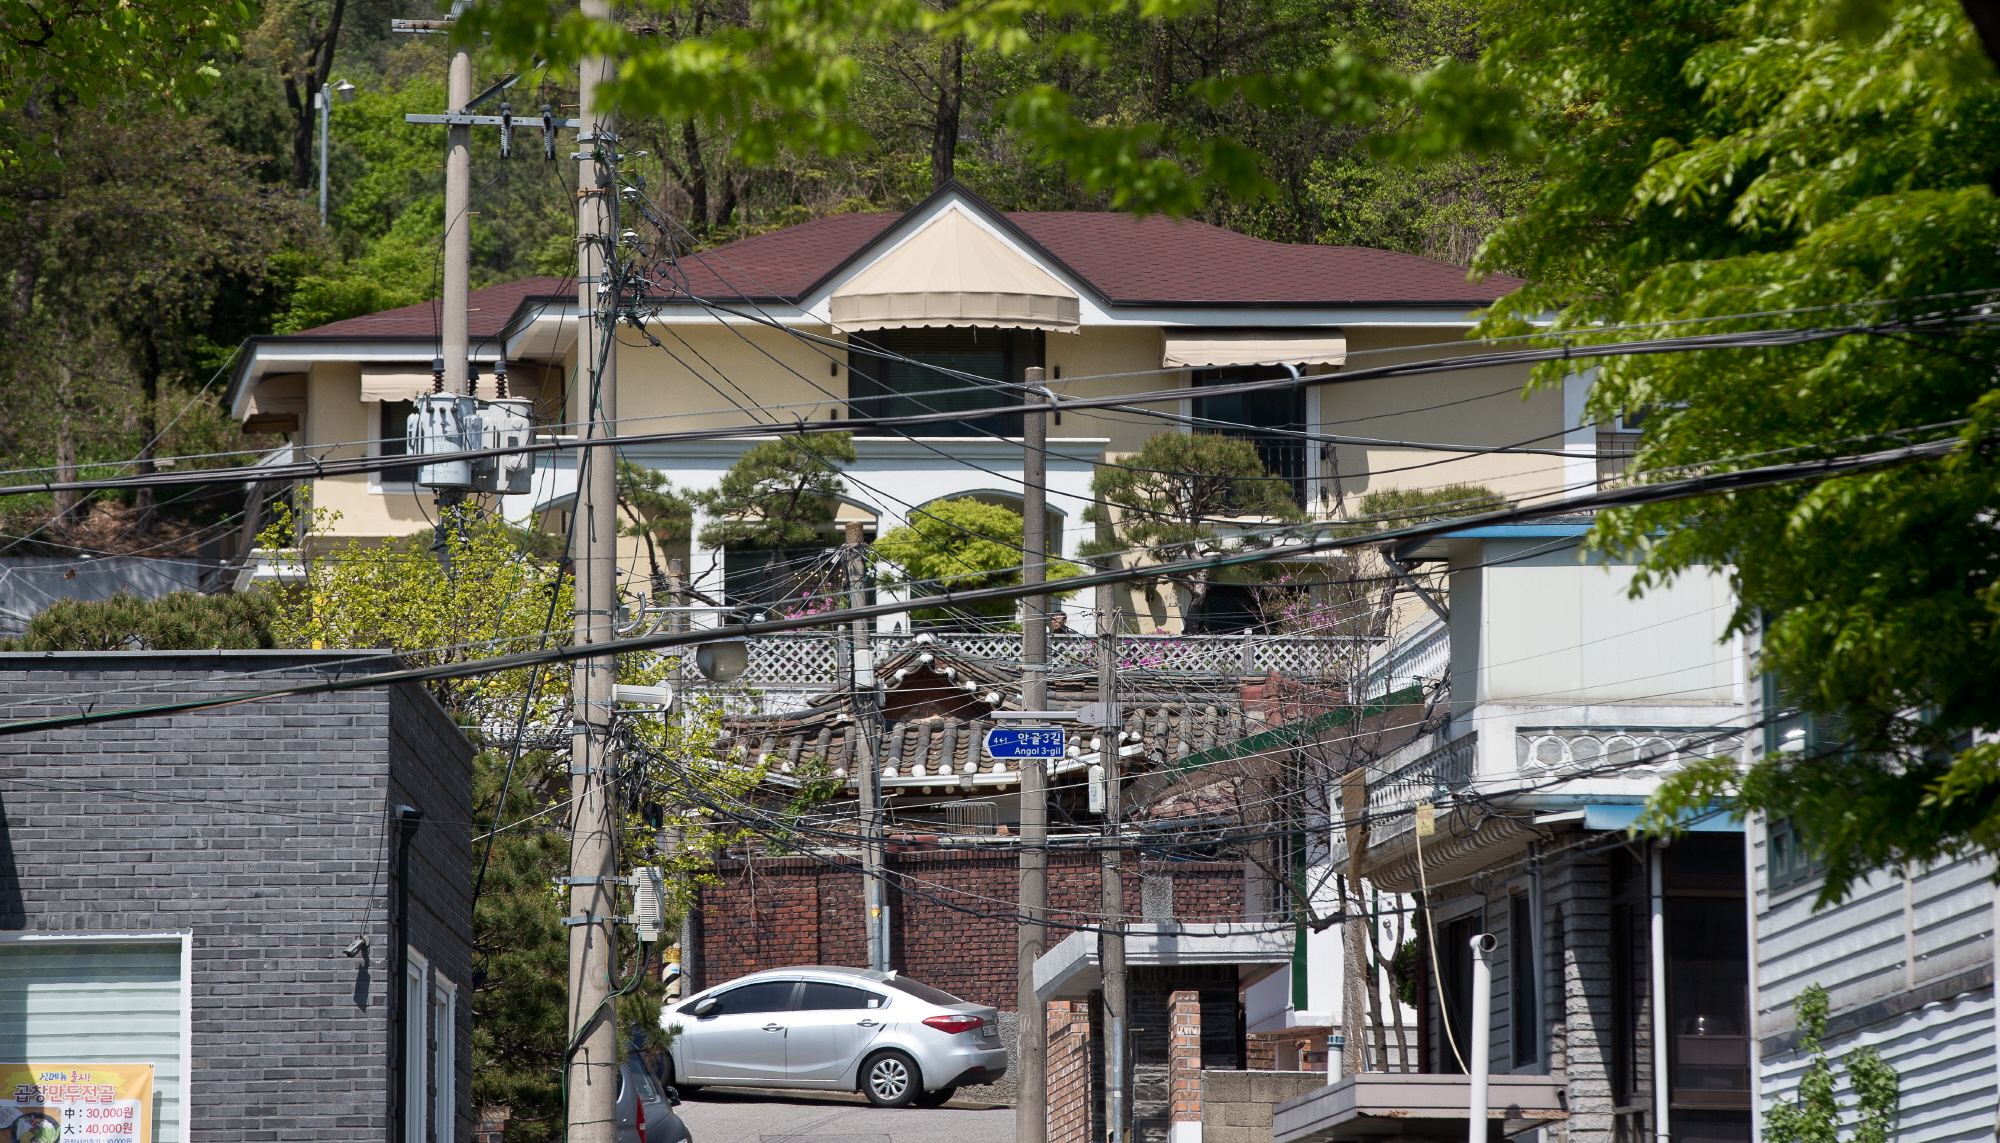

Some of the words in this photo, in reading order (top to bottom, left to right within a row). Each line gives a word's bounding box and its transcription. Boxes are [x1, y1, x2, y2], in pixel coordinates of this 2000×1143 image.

[1017, 732, 1061, 745] 안골3길
[1014, 747, 1040, 757] Angol
[1041, 747, 1061, 757] 3-gil
[39, 1071, 68, 1082] 신메뉴
[70, 1070, 91, 1083] 출시!
[14, 1084, 115, 1103] 곱창만두전골
[64, 1107, 75, 1119] 中
[86, 1106, 134, 1120] 30,000원
[64, 1123, 75, 1135] 大
[85, 1122, 133, 1135] 40,000원
